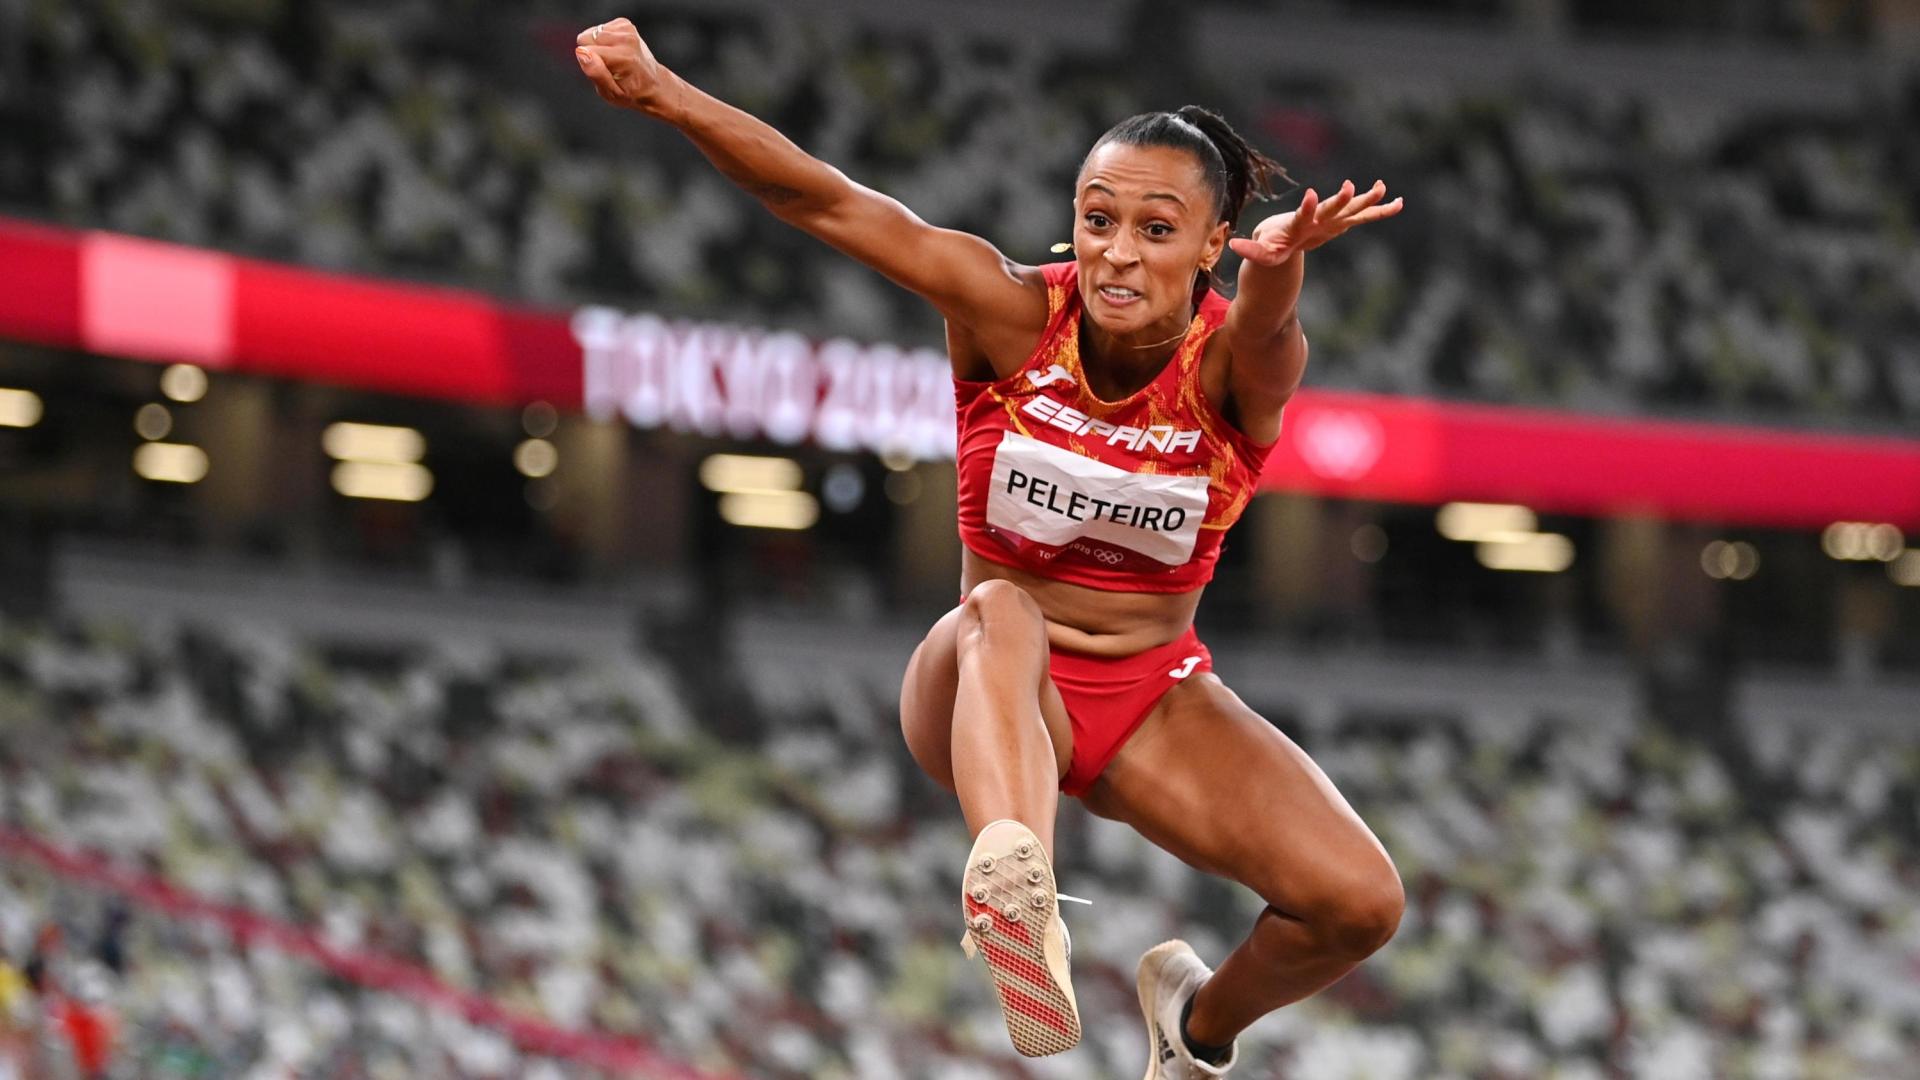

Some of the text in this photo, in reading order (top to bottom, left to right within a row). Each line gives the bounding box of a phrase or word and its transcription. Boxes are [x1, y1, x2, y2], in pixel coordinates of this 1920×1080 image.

[572, 306, 957, 461] TOKYO 202
[1022, 394, 1202, 454] ESPAÑA
[1007, 469, 1186, 531] PELETEIRO
